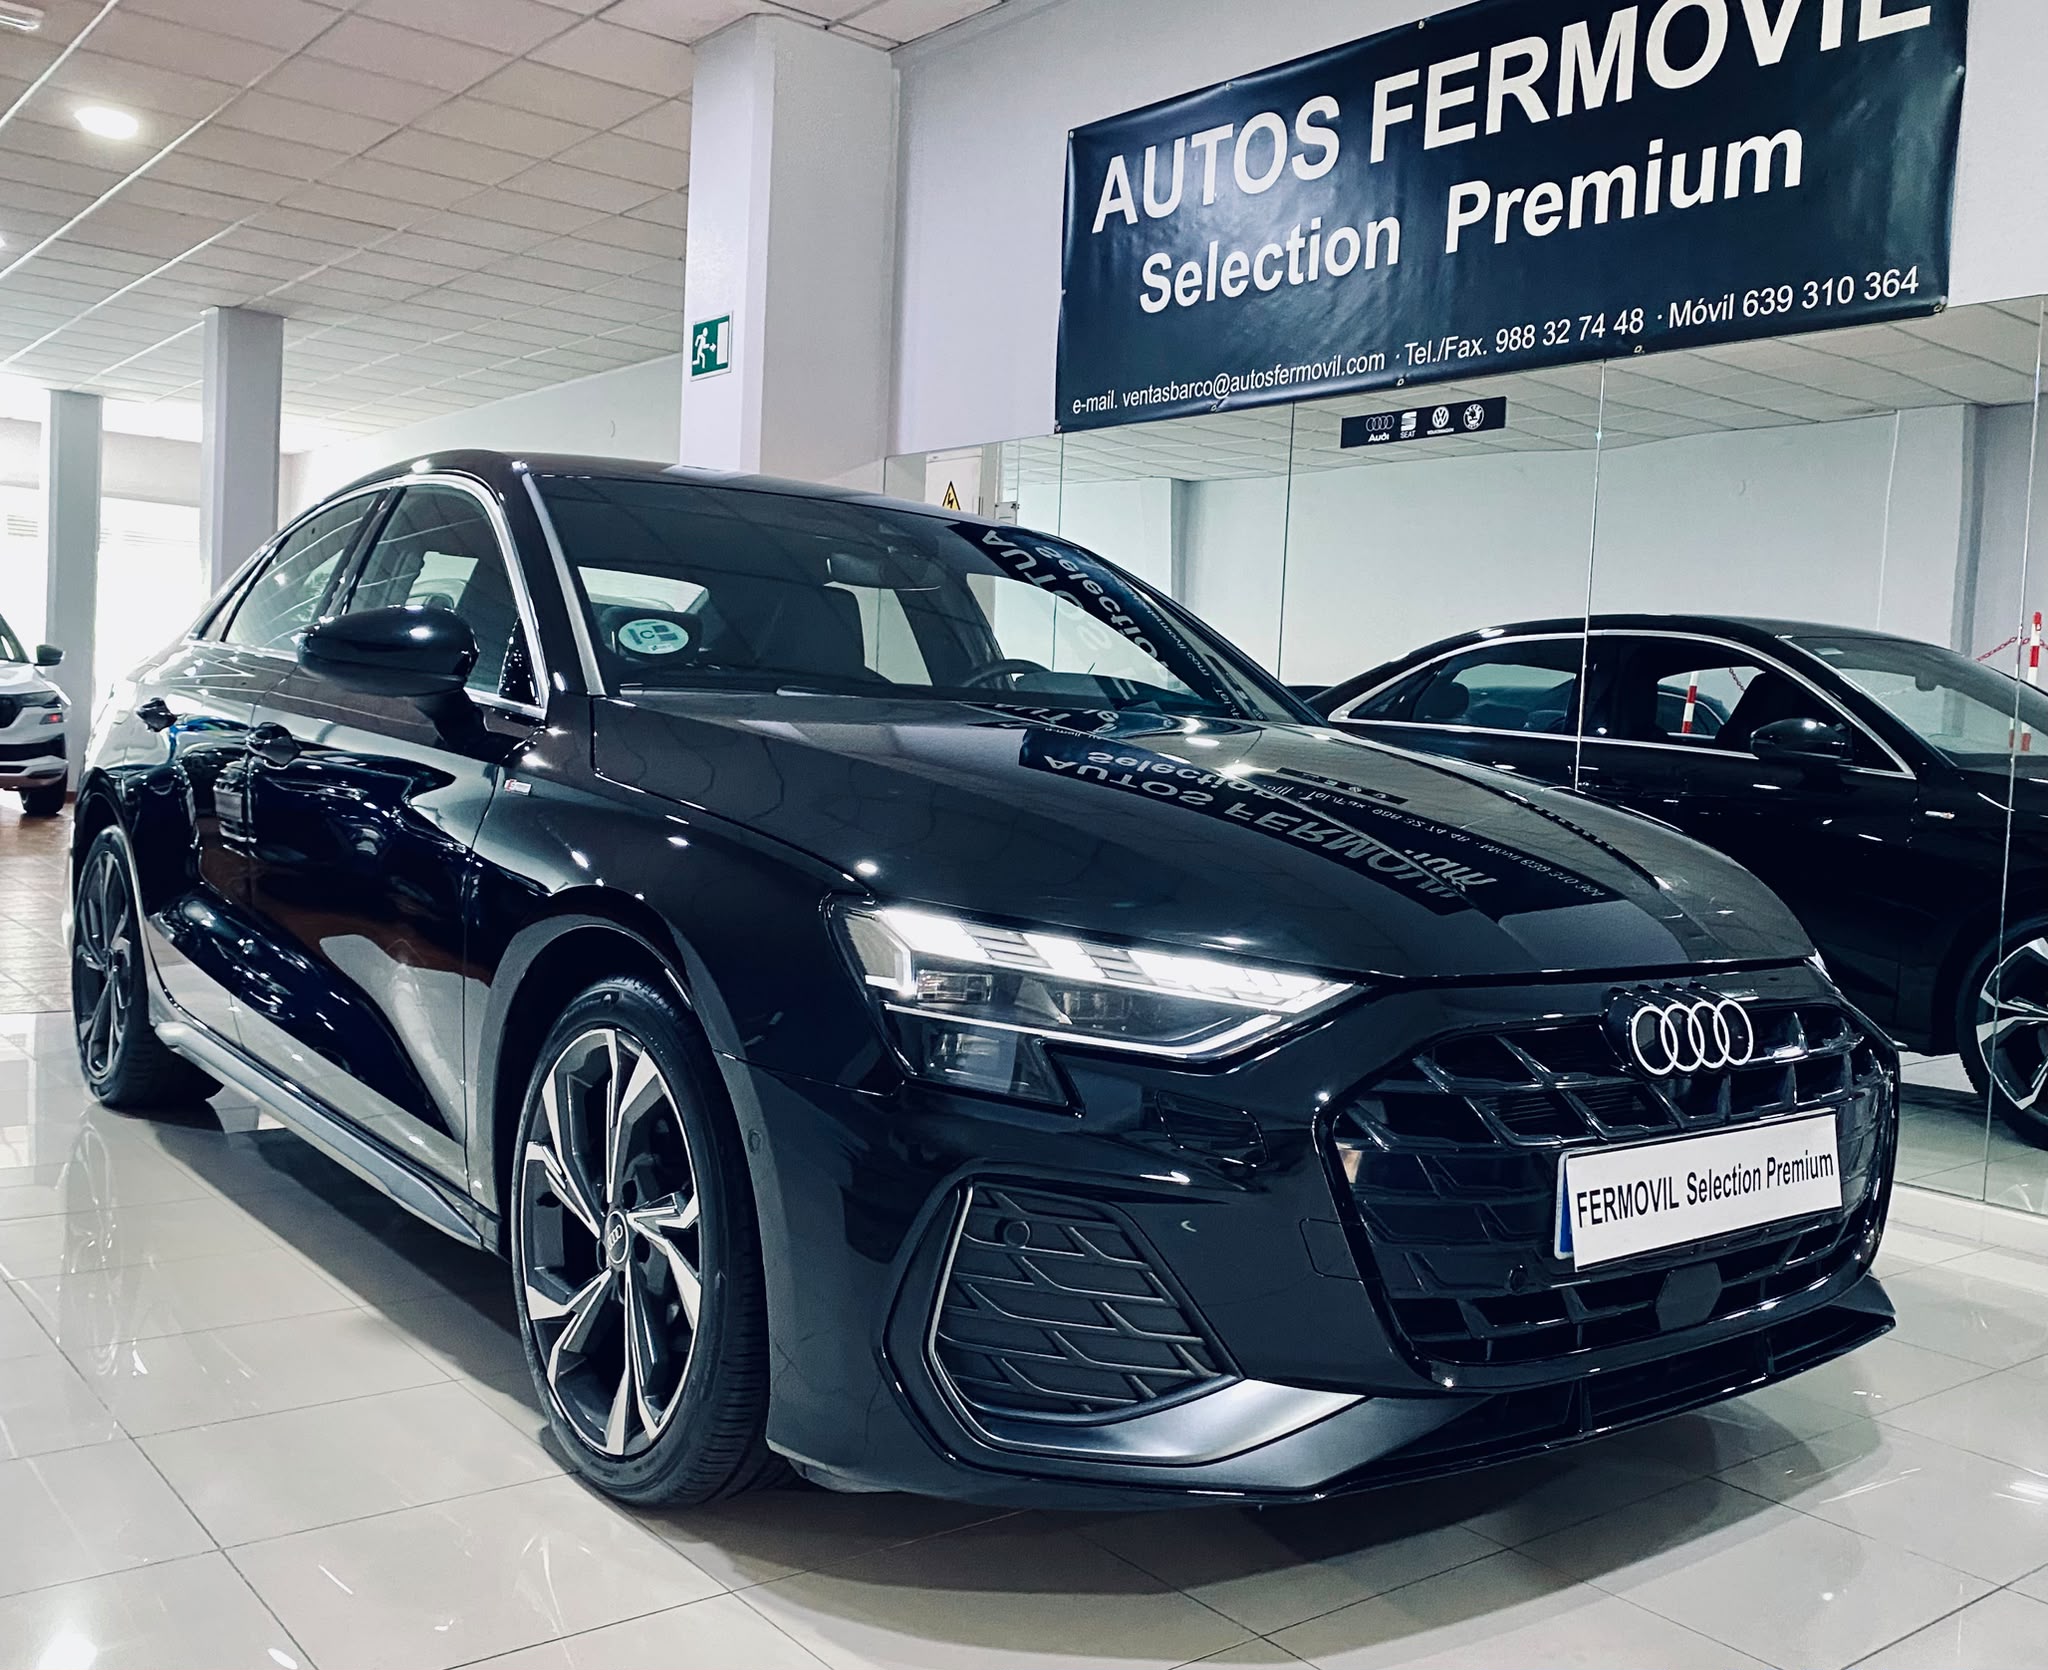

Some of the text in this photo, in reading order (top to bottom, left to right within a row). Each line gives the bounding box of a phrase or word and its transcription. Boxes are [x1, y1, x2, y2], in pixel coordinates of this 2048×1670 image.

[1092, 0, 1932, 234] AUTOS FERMOVIL
[1139, 129, 1803, 314] Selection Premium
[1072, 265, 1920, 414] e-mail. ventasbarco@autosfermovil.com Tel./Fax. 988 32 74 48 Móvil 639 310 364
[1368, 432, 1390, 442] Audi
[1576, 1149, 1834, 1228] FERMOVIL Selection Premium
